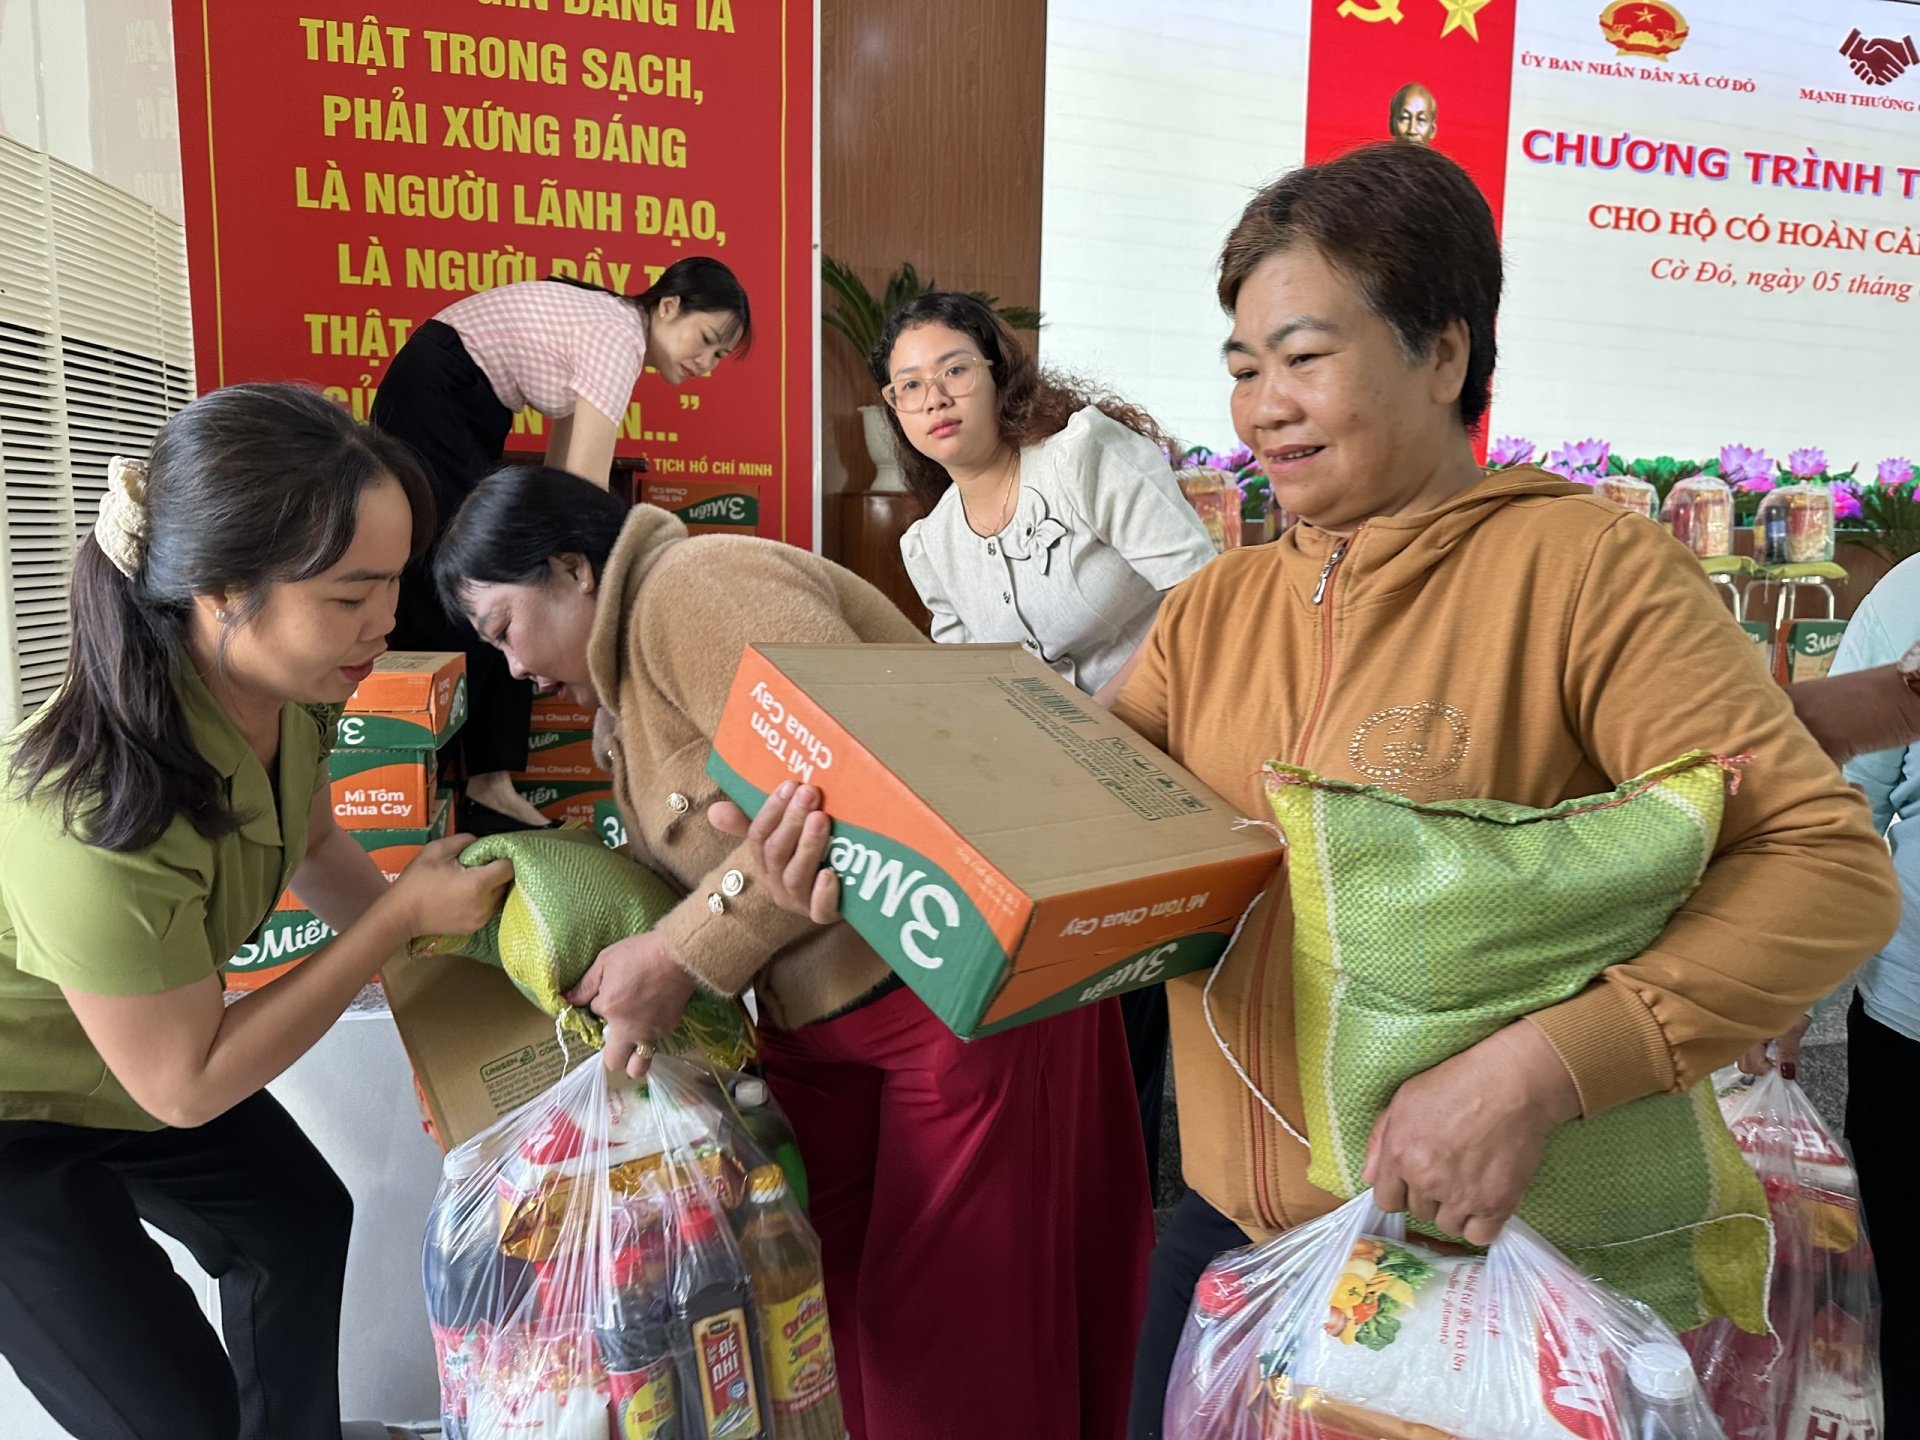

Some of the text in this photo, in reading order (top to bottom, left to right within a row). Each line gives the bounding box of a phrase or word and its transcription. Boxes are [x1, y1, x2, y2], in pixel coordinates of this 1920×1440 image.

[299, 14, 704, 105] THẬT TRONG SẠCH,
[1521, 51, 1756, 93] ỦY BAN NHÂN DÂN XÃ CỜ ĐỎ
[1800, 88, 1847, 104] MẠNH
[1850, 94, 1914, 112] THƯỜNG
[323, 86, 687, 169] PHẢI XỨNG ĐÁNG
[1522, 129, 1920, 198] CHƯƠNG TRÌNH T
[295, 160, 726, 247] LÀ NGƯỜI LÃNH ĐẠO,
[1588, 204, 1661, 233] CHO
[1670, 208, 1716, 241] HỘ
[1725, 213, 1770, 243] CÓ
[1777, 220, 1867, 251] HOÀN
[338, 236, 392, 287] LÀ
[406, 244, 537, 293] NGƯỜI
[1651, 257, 1689, 281] Cờ
[1695, 261, 1737, 287] Đỏ,
[1746, 266, 1805, 293] ngày
[1812, 270, 1840, 292] 05
[1848, 274, 1912, 303] tháng
[304, 308, 412, 367] THẬT
[653, 458, 685, 474] TỊCH
[712, 459, 735, 475] CHÍ
[739, 462, 772, 477] MINH
[749, 681, 833, 769] Chua Cay
[751, 712, 788, 762] Tôm
[334, 803, 413, 817] Chua Cay
[344, 788, 404, 802] Mì Tôm
[1059, 917, 1099, 937] Cay
[1101, 907, 1149, 928] Chua
